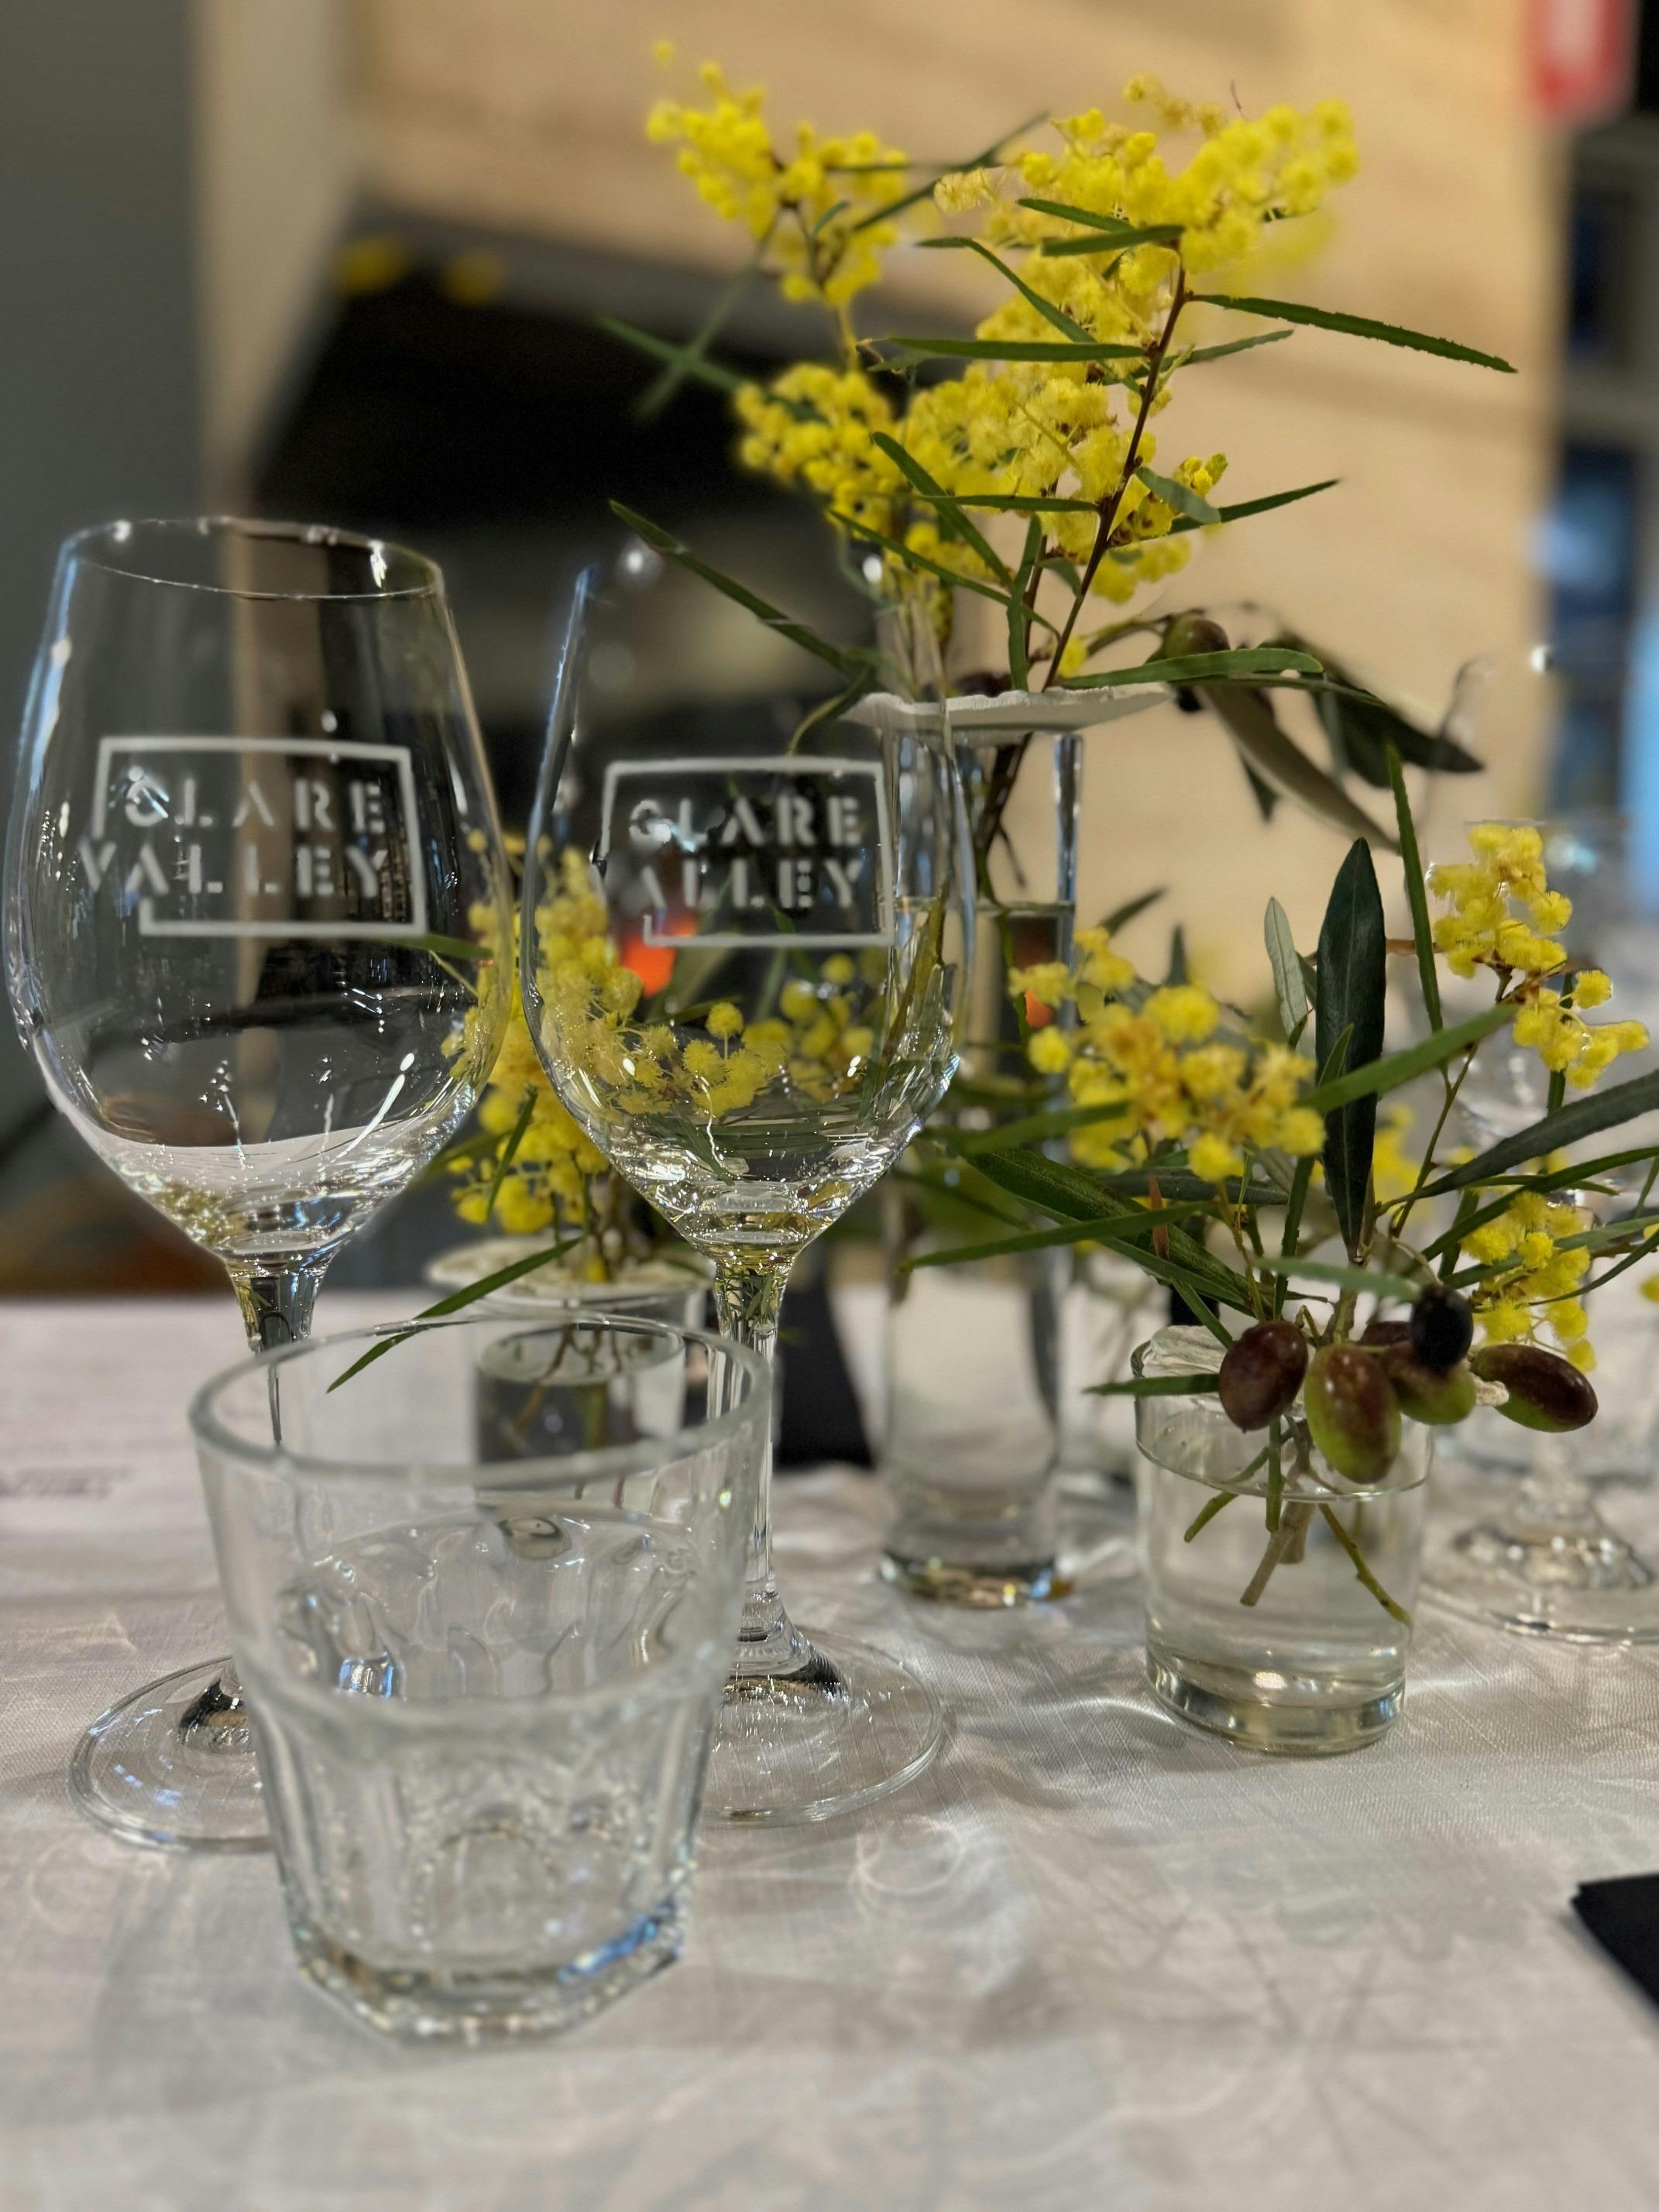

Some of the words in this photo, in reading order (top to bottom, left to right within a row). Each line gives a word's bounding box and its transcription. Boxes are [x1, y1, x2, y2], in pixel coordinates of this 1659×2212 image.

[125, 778, 386, 833] CLARE
[629, 795, 863, 850] CLARE
[78, 842, 390, 898] VALLEY
